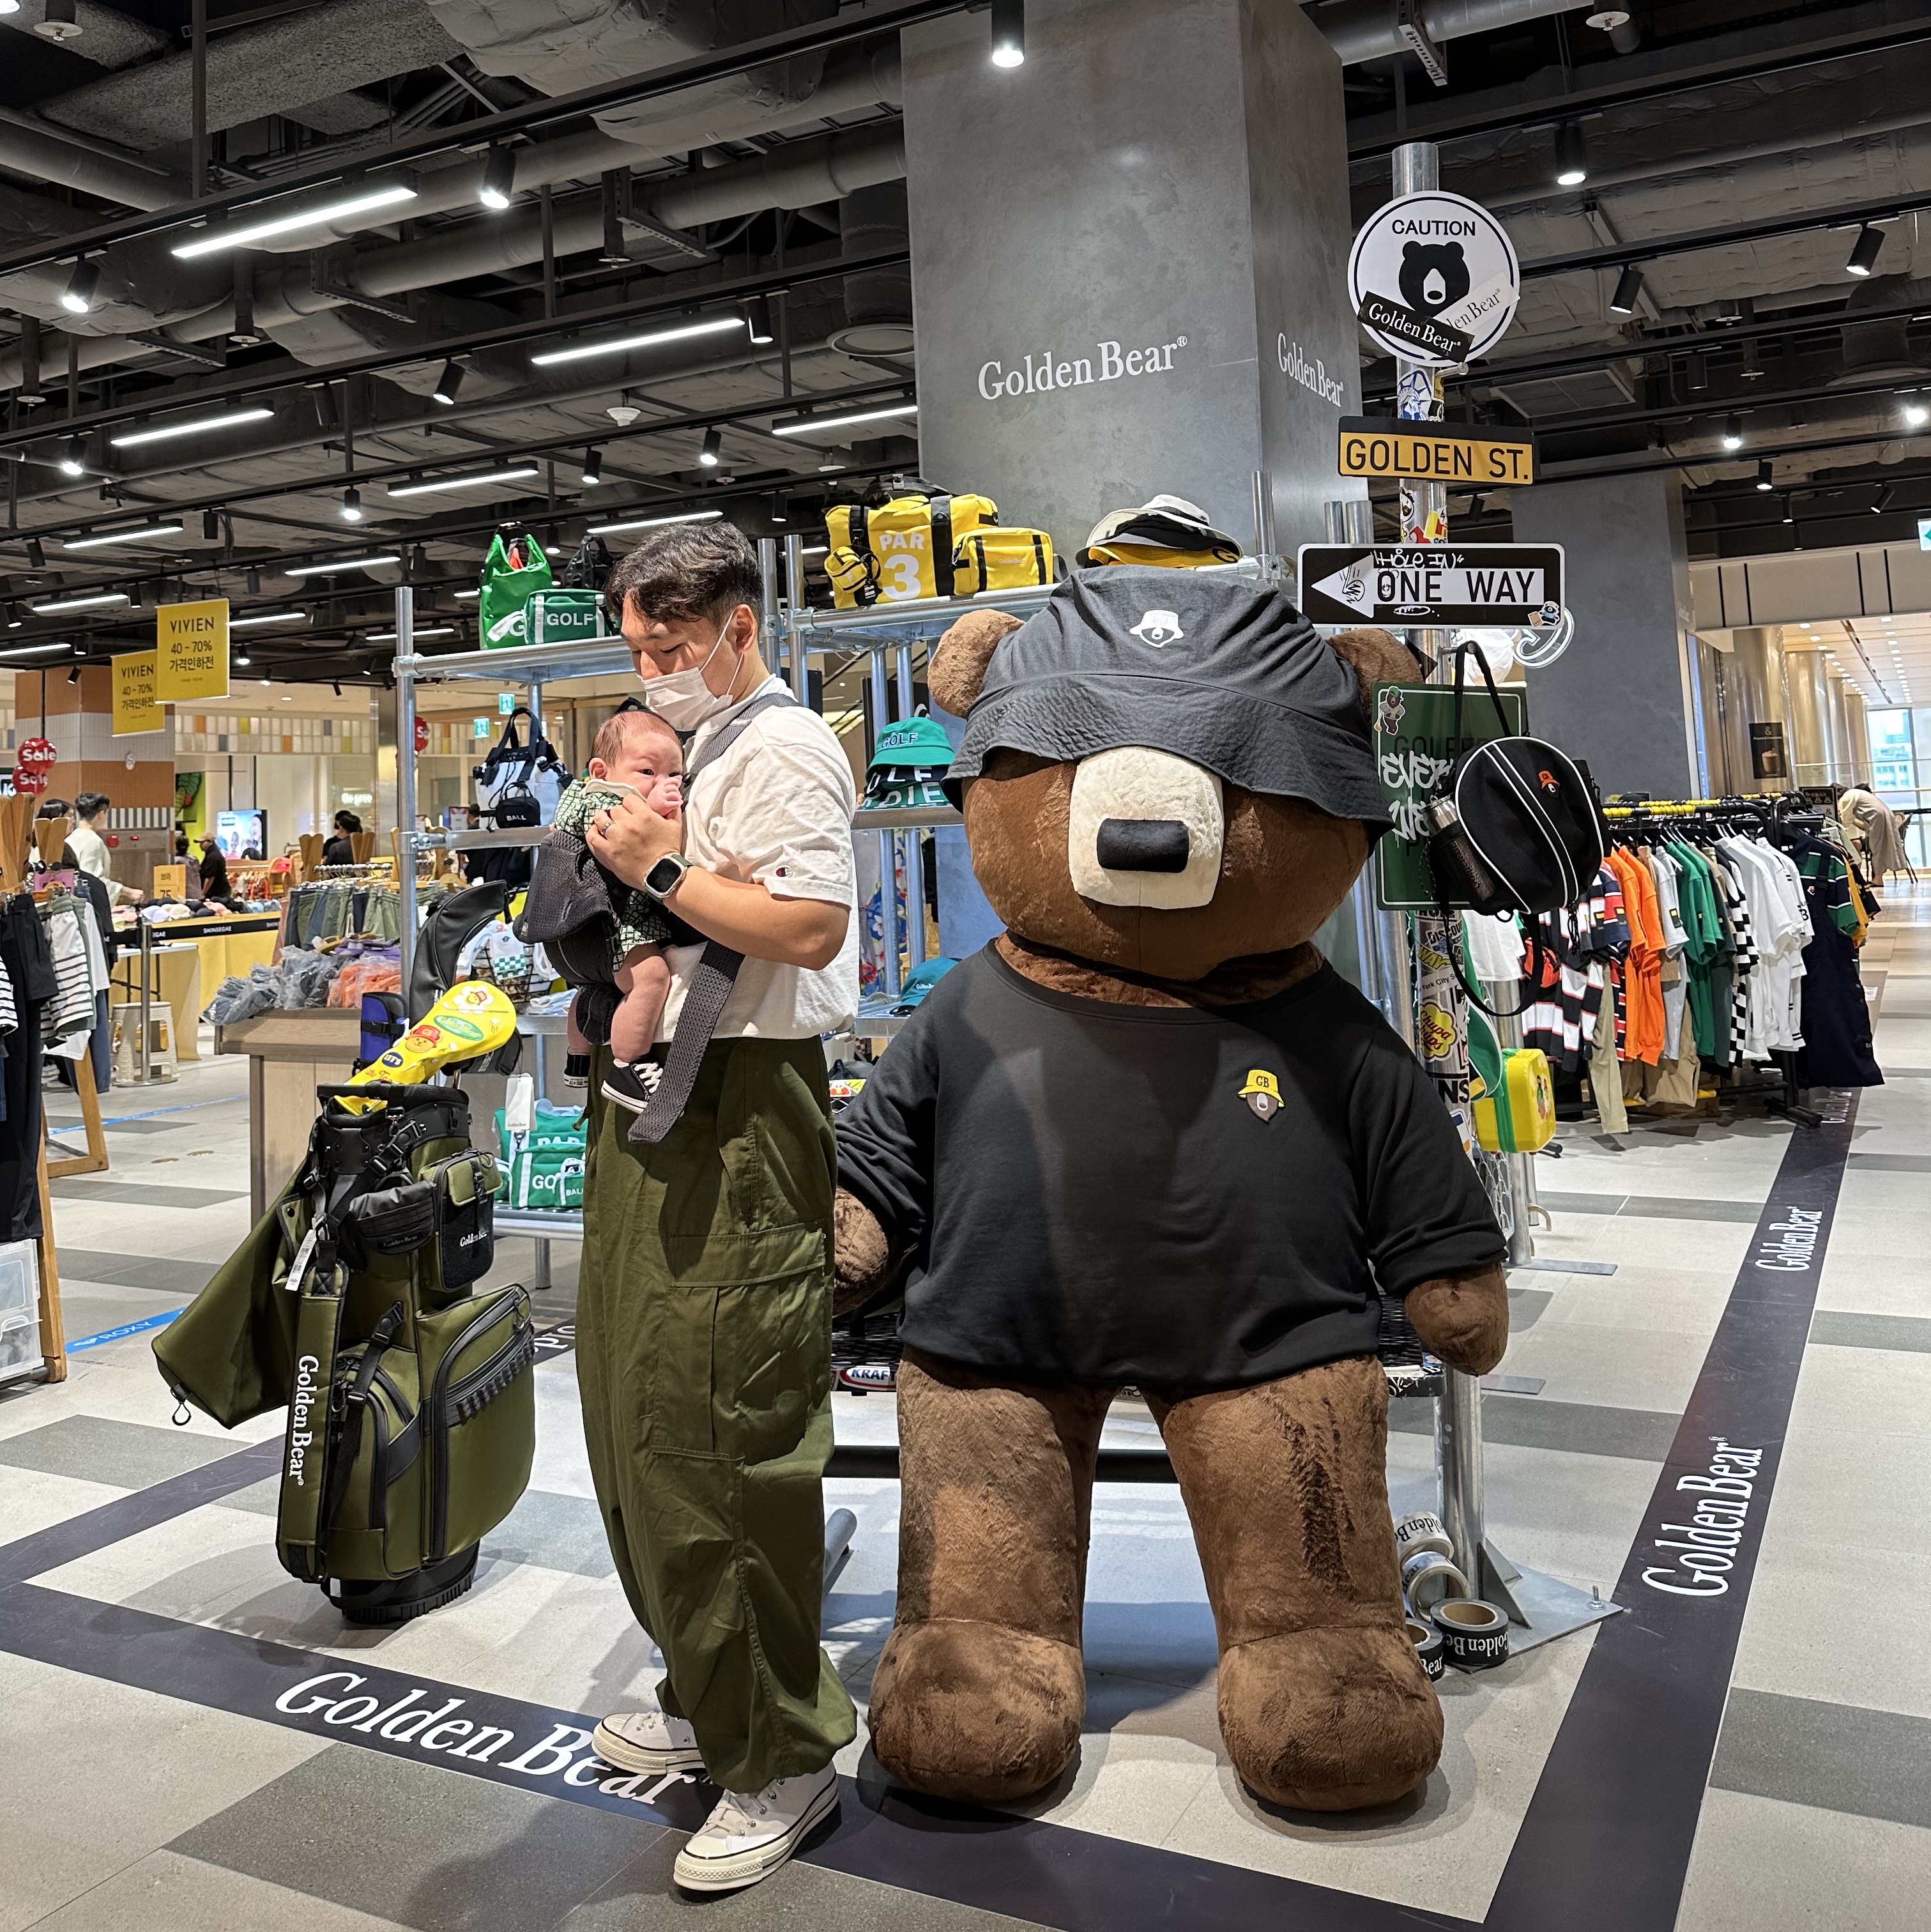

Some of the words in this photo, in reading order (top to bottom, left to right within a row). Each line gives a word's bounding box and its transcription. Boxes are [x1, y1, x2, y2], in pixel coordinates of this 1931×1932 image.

[1391, 219, 1476, 236] CAUTION
[1369, 302, 1421, 338] Golden
[1278, 332, 1318, 393] Golden
[977, 351, 1094, 400] Golden
[1346, 438, 1472, 476] GOLDEN
[1488, 447, 1529, 480] ST.
[879, 532, 925, 551] PAR
[882, 553, 922, 601] 3
[1377, 570, 1443, 602] ONE
[1465, 570, 1535, 603] WAY
[169, 617, 215, 634] VIVIEN
[546, 613, 594, 626] GOLF
[192, 640, 213, 653] 70%
[121, 664, 154, 679] VIVIEN
[169, 656, 215, 672] 가격인하전
[121, 696, 155, 710] 가격인하전
[881, 732, 919, 749] GOLF
[22, 747, 57, 762] Sale
[19, 772, 49, 786] Sale
[160, 889, 172, 898] 75
[1421, 982, 1435, 991] York
[1435, 977, 1449, 985] City
[1420, 1010, 1452, 1040] Chupa
[1256, 1075, 1270, 1088] GB
[383, 1239, 404, 1247] Golden
[1755, 1232, 1817, 1271] Golden
[98, 1321, 153, 1340] ROXY
[293, 1355, 319, 1429] Golden
[1407, 1517, 1443, 1534] olden
[1642, 1499, 1750, 1597] Golden
[275, 1671, 515, 1762] Golden
